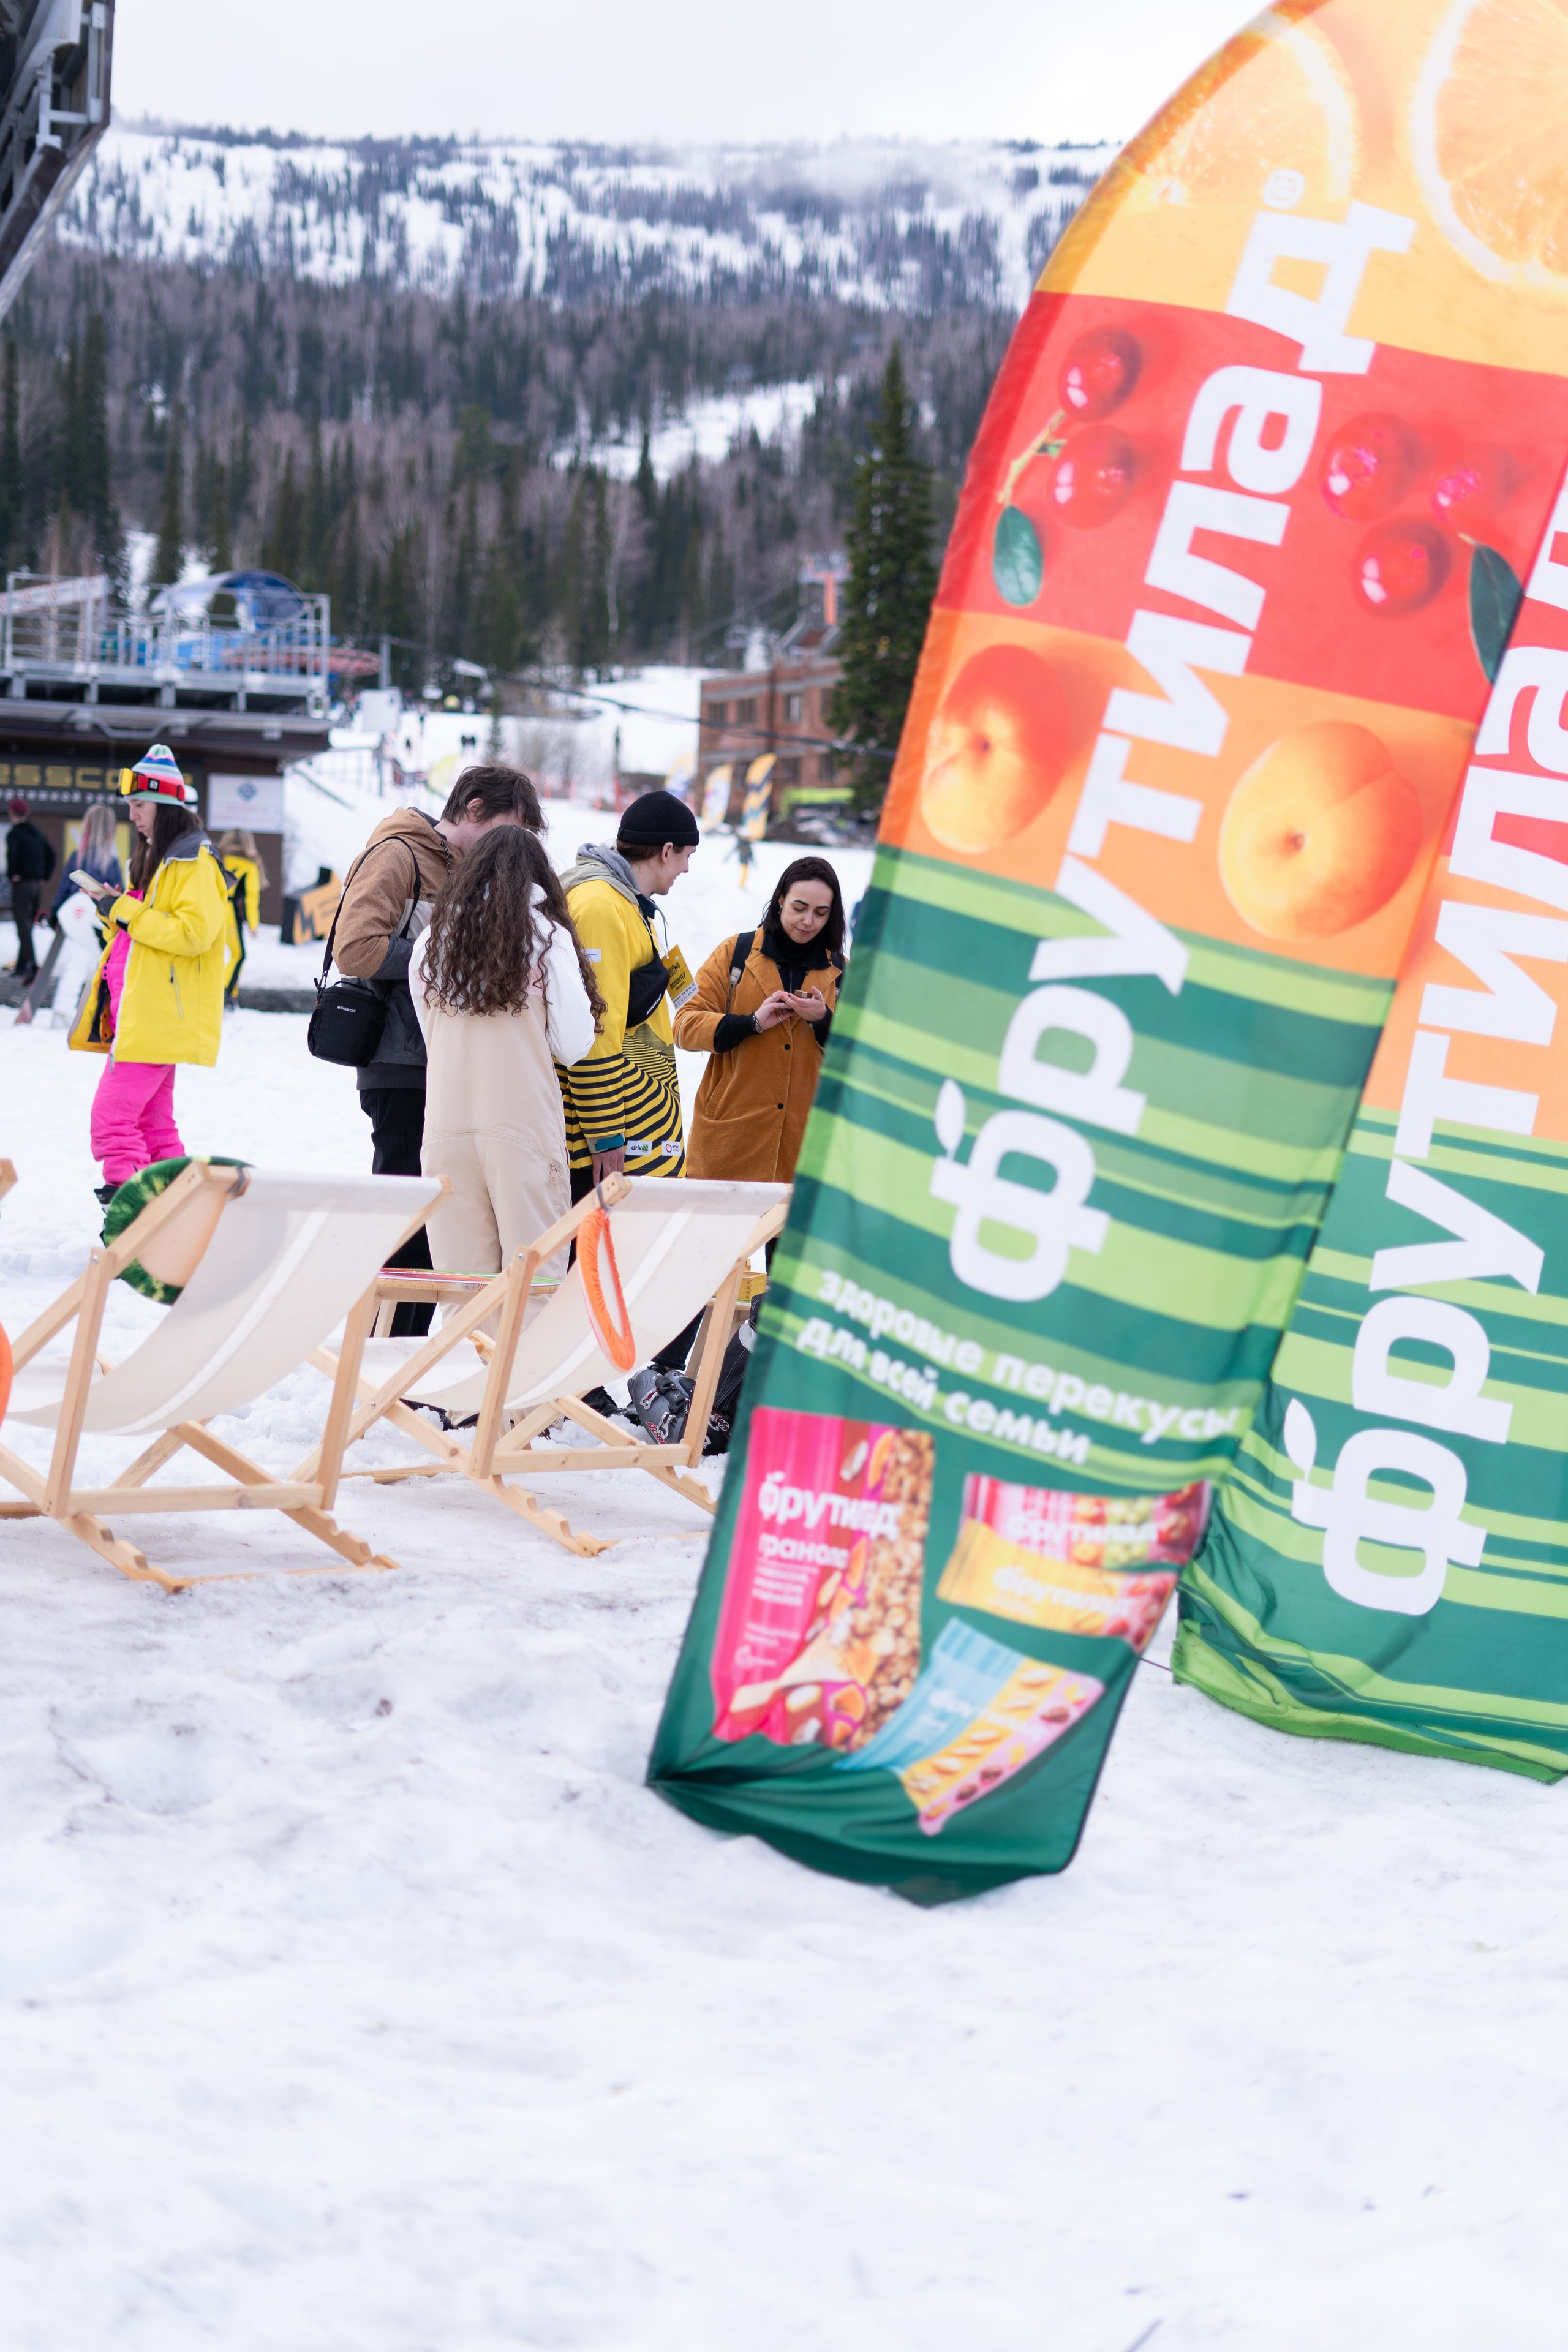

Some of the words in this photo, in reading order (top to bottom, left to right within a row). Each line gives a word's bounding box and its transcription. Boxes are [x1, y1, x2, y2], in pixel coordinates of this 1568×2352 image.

[797, 1316, 868, 1371] для
[869, 1349, 940, 1412] всей
[943, 1391, 1091, 1466] семьи
[817, 1270, 984, 1374] здоровые
[992, 1352, 1240, 1444] перекусы
